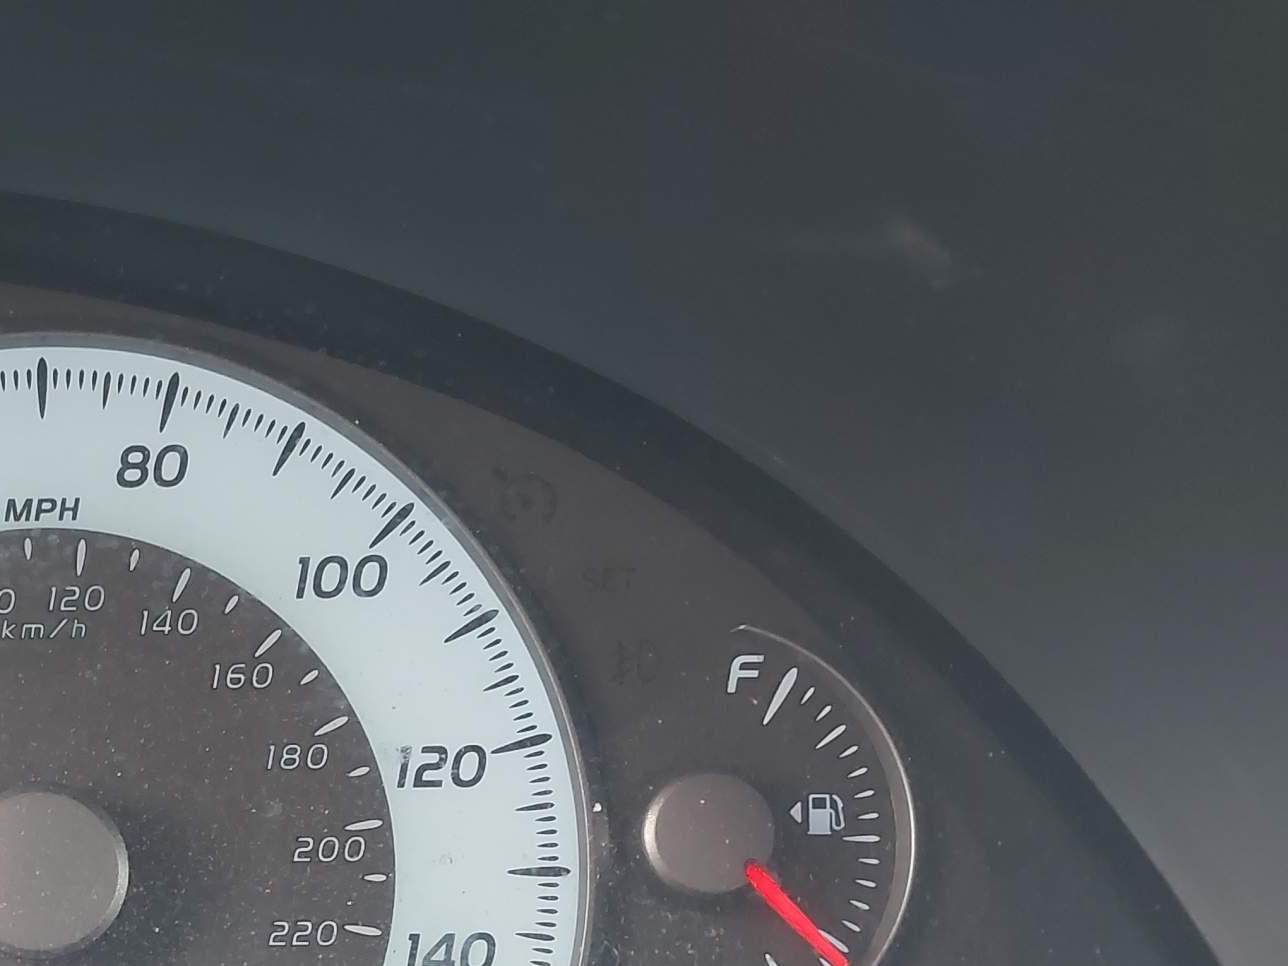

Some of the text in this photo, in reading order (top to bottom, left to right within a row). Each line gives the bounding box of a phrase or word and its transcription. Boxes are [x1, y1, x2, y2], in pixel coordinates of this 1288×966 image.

[117, 444, 189, 488] 80
[4, 498, 80, 522] MPH
[296, 555, 388, 599] 100
[49, 585, 105, 612] 120
[1, 618, 86, 639] km/h
[141, 609, 198, 635] 140
[212, 663, 273, 689] 160
[727, 655, 765, 693] F
[267, 744, 328, 770] 180
[396, 744, 487, 787] 120
[293, 836, 366, 862] 200
[268, 920, 338, 946] 220
